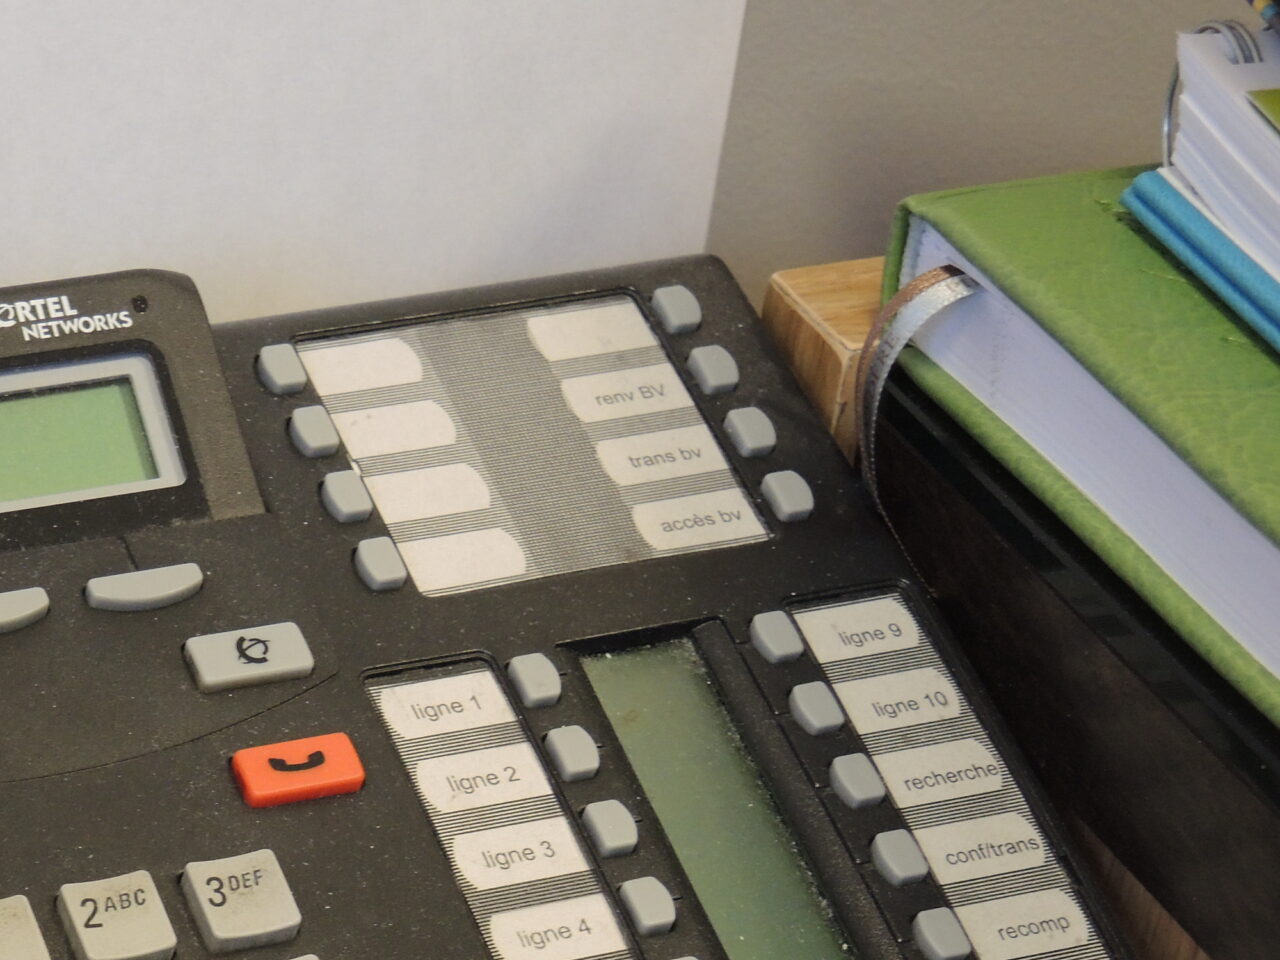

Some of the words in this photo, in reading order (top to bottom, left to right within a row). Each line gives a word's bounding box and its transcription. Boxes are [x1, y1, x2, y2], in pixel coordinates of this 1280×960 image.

[21, 311, 133, 341] NETWORKS
[595, 390, 634, 406] renv
[638, 384, 666, 399] BV
[628, 450, 677, 468] trans
[678, 447, 702, 461] bv
[661, 514, 716, 533] accès
[717, 509, 741, 523] bv
[837, 626, 885, 648] ligne
[888, 621, 902, 638] 9
[410, 698, 464, 722] ligne
[470, 695, 483, 711] 1
[872, 697, 920, 720] ligne
[923, 690, 949, 707] 10
[445, 771, 499, 795] ligne
[503, 765, 521, 783] 2
[903, 761, 999, 791] recherche
[481, 845, 535, 871] ligne
[539, 841, 556, 859] 3
[945, 836, 1040, 867] conf/trans
[515, 924, 571, 949] ligne
[576, 918, 593, 937] 4
[997, 915, 1071, 942] recomp
